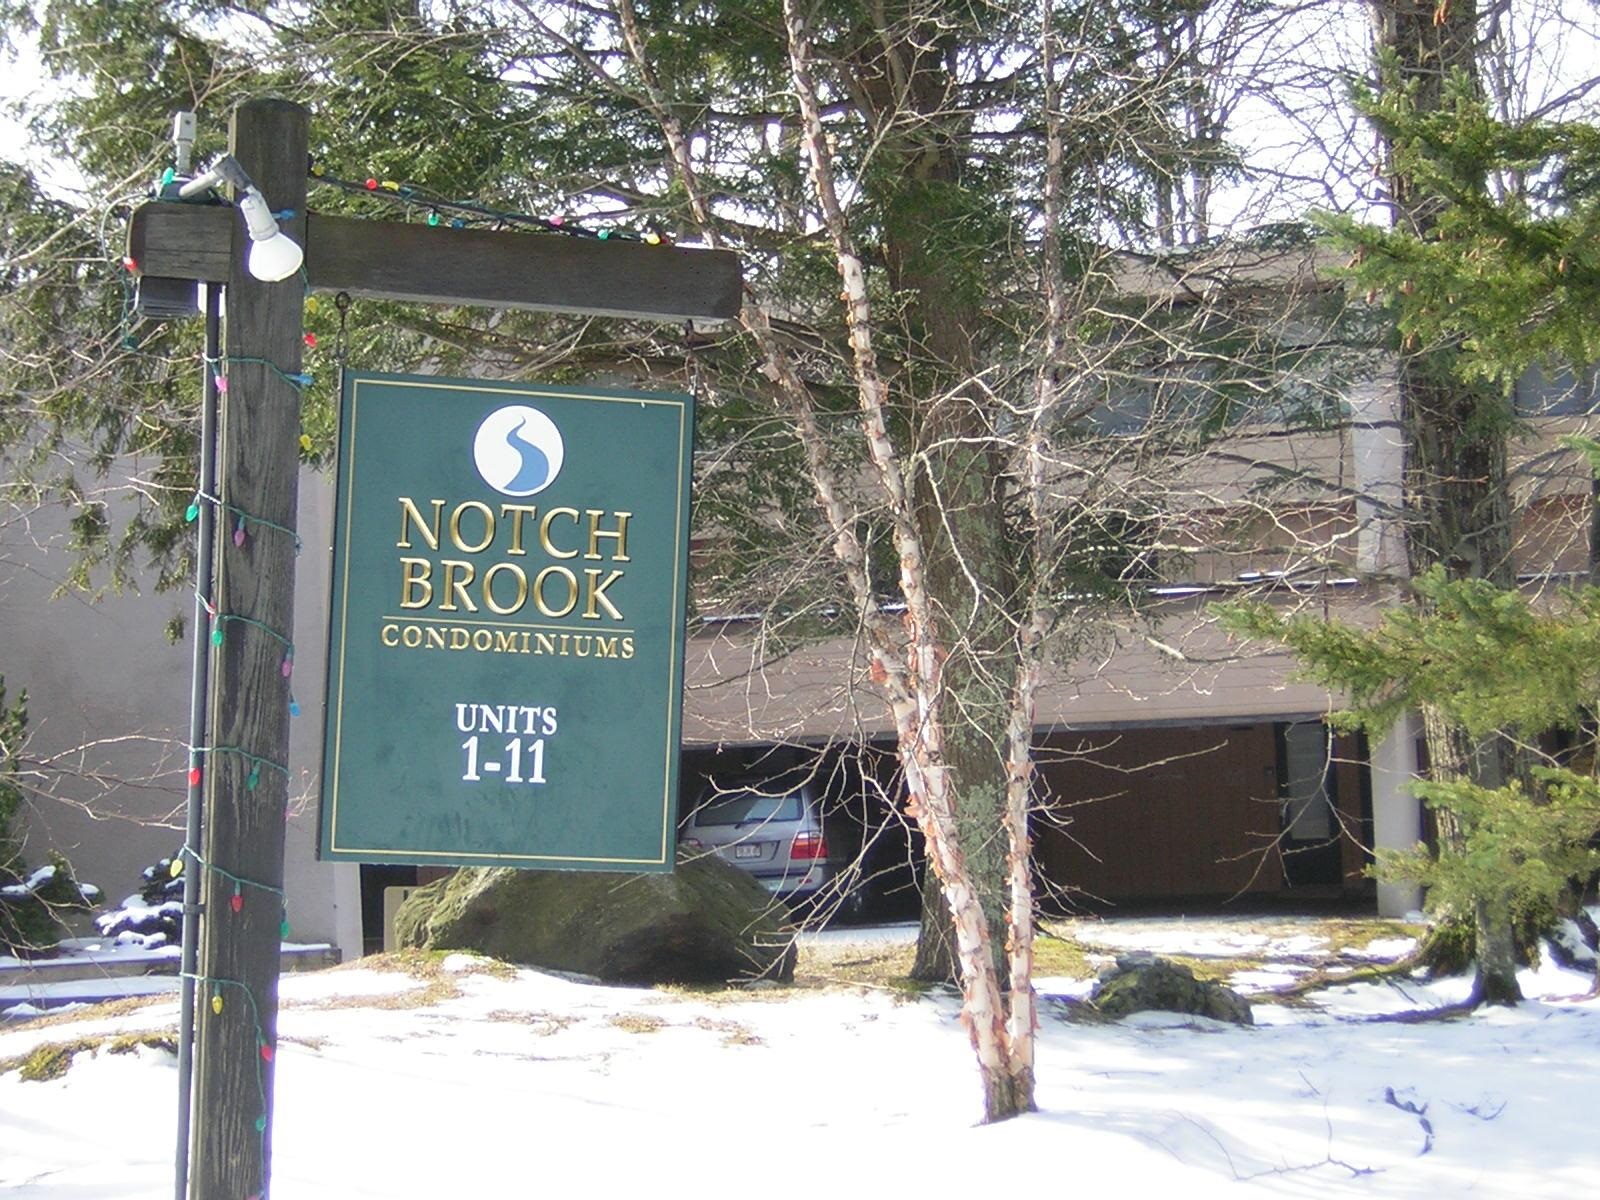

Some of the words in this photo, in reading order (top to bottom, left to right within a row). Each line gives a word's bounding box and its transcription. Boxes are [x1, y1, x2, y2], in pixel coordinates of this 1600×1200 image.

[396, 497, 633, 561] NOTCH
[400, 557, 624, 620] BROOK
[381, 624, 635, 659] CONDOMINIUMS
[455, 703, 558, 735] UNITS
[462, 736, 546, 783] 1-11
